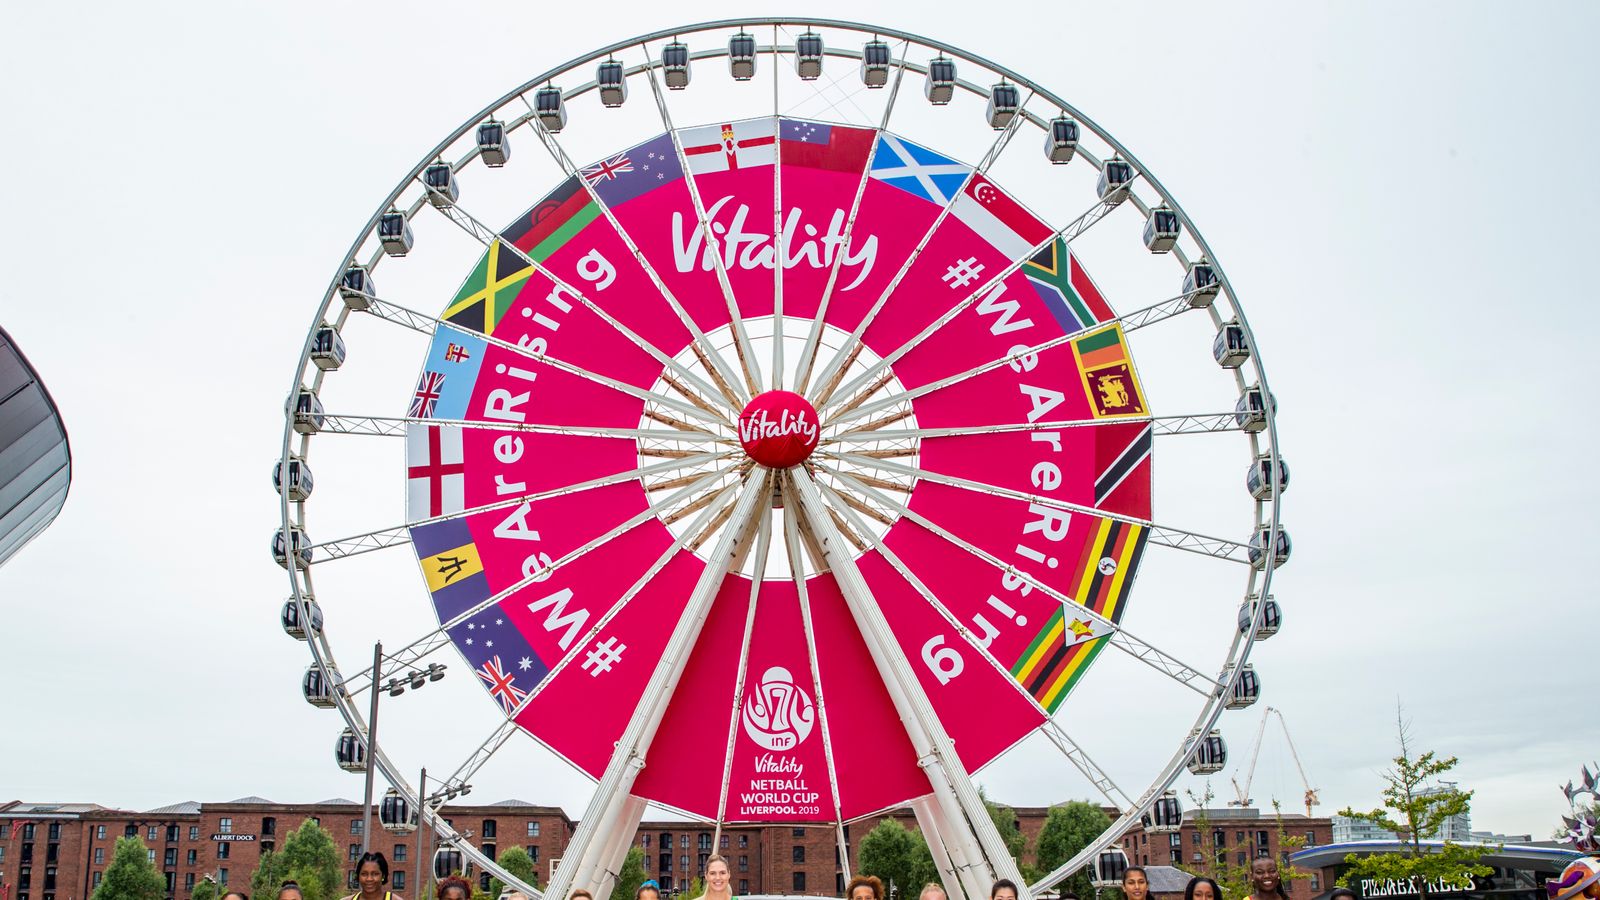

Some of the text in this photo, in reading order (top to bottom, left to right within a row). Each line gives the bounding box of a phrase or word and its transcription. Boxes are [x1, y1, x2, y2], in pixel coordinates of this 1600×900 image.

[672, 195, 879, 292] Vitality
[740, 407, 817, 446] Vitality
[483, 248, 628, 678] #WeAreRising
[921, 256, 1073, 686] #WeAreRising
[755, 752, 804, 780] Vitality
[740, 792, 819, 804] WORLD CUP
[750, 779, 808, 790] NETBALL
[740, 805, 820, 815] LIVERPOOL 2019
